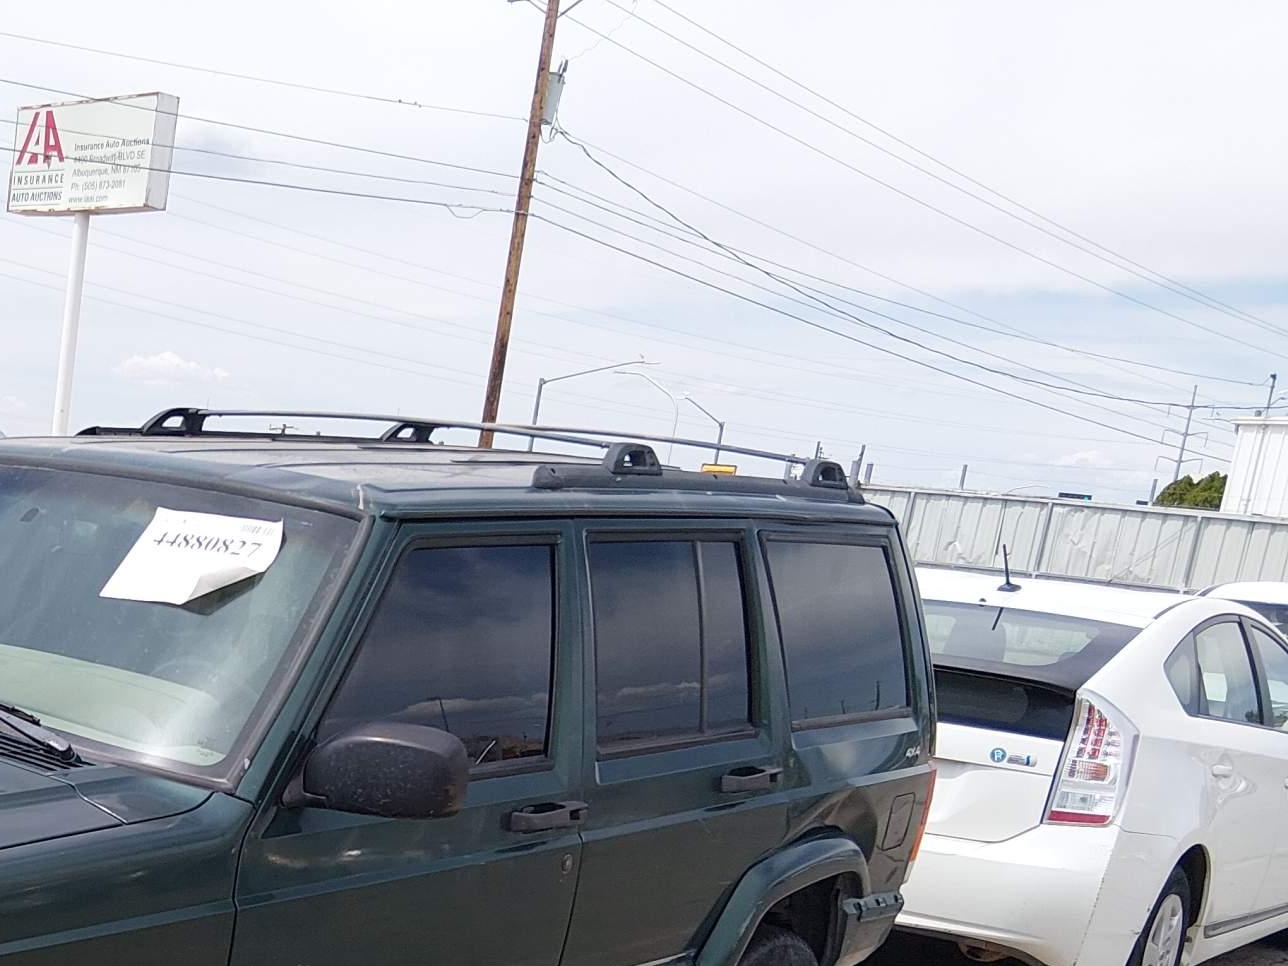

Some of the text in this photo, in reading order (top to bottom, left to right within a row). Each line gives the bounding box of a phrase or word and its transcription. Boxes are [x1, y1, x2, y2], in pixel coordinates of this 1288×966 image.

[74, 137, 150, 151] Insurance Auto Auctions
[137, 150, 145, 159] SE
[13, 173, 64, 185] INSURANCE
[11, 191, 62, 203] AUTO AUCTIONS
[153, 531, 263, 558] 44880827
